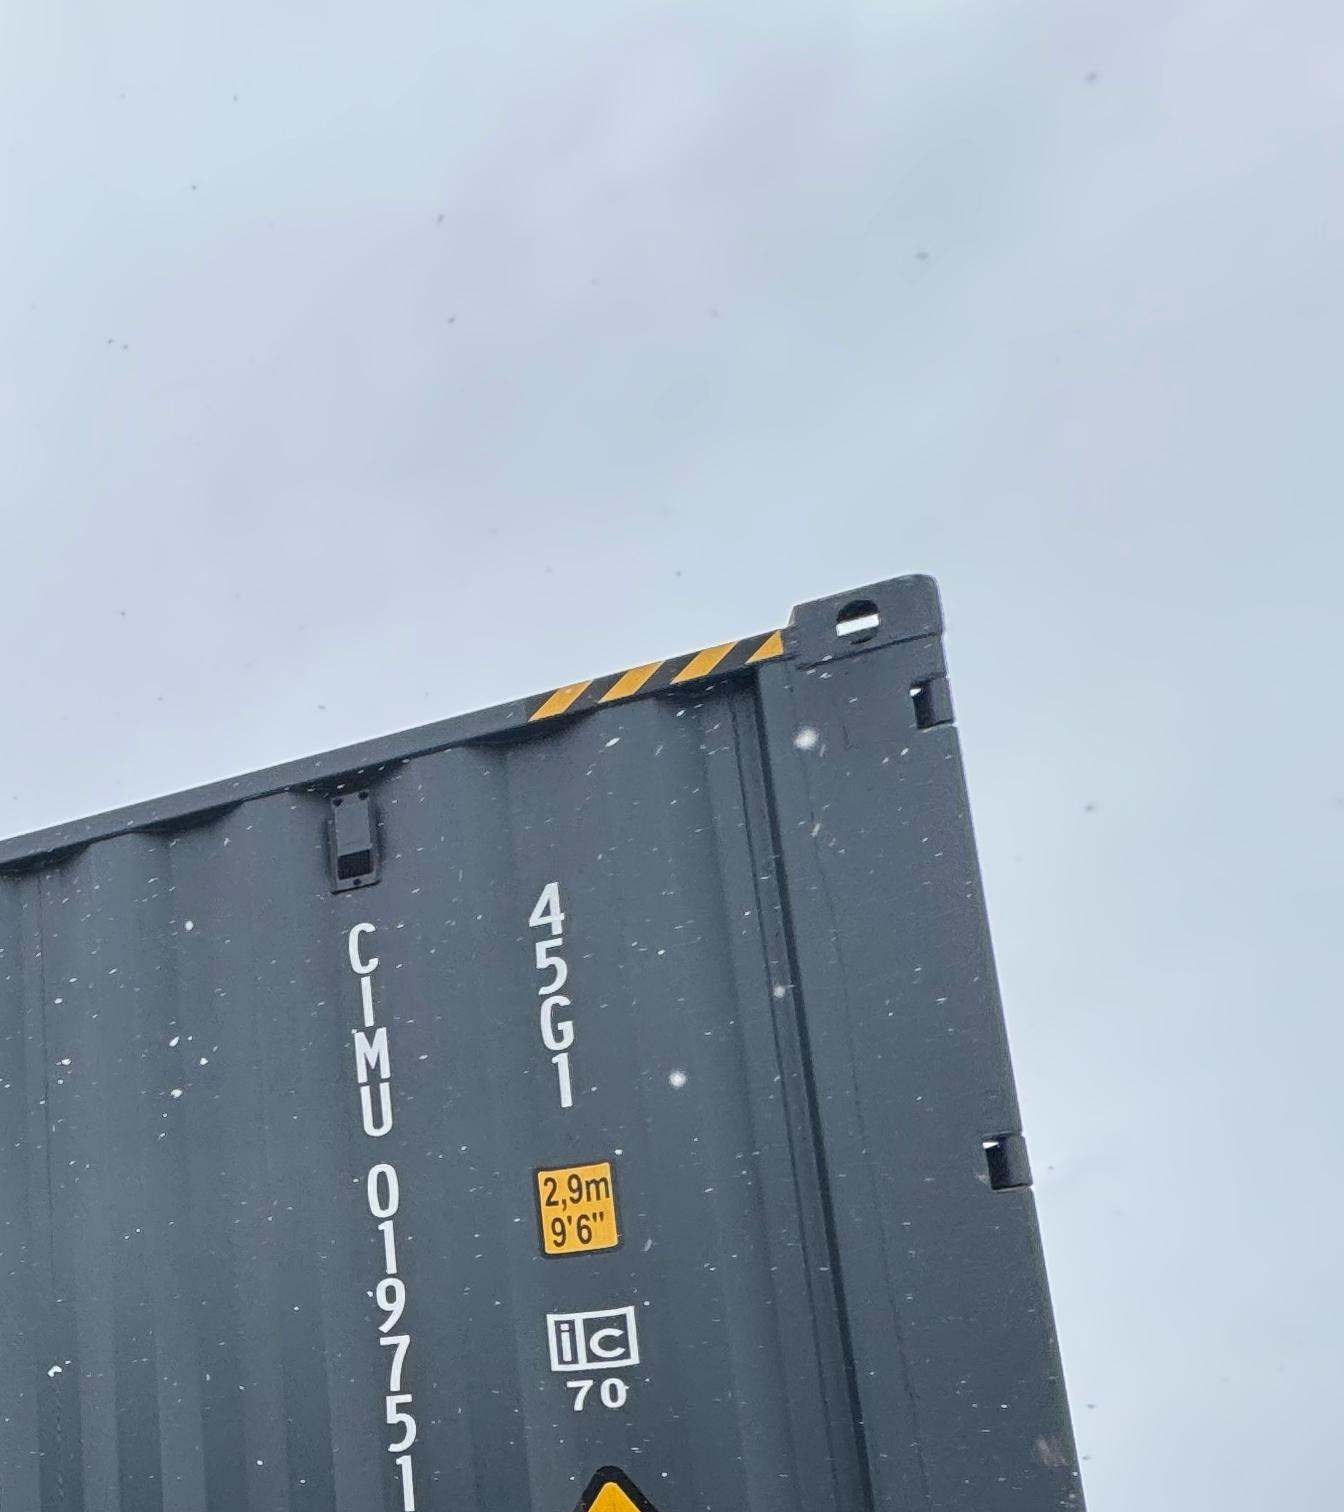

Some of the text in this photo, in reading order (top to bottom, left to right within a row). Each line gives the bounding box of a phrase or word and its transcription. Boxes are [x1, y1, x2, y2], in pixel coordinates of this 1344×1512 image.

[348, 922, 394, 1137] CIMU
[529, 882, 575, 1107] 45G1
[543, 1173, 610, 1212] 2,9m
[367, 1163, 417, 1512] 019751
[566, 1377, 627, 1411] 70
